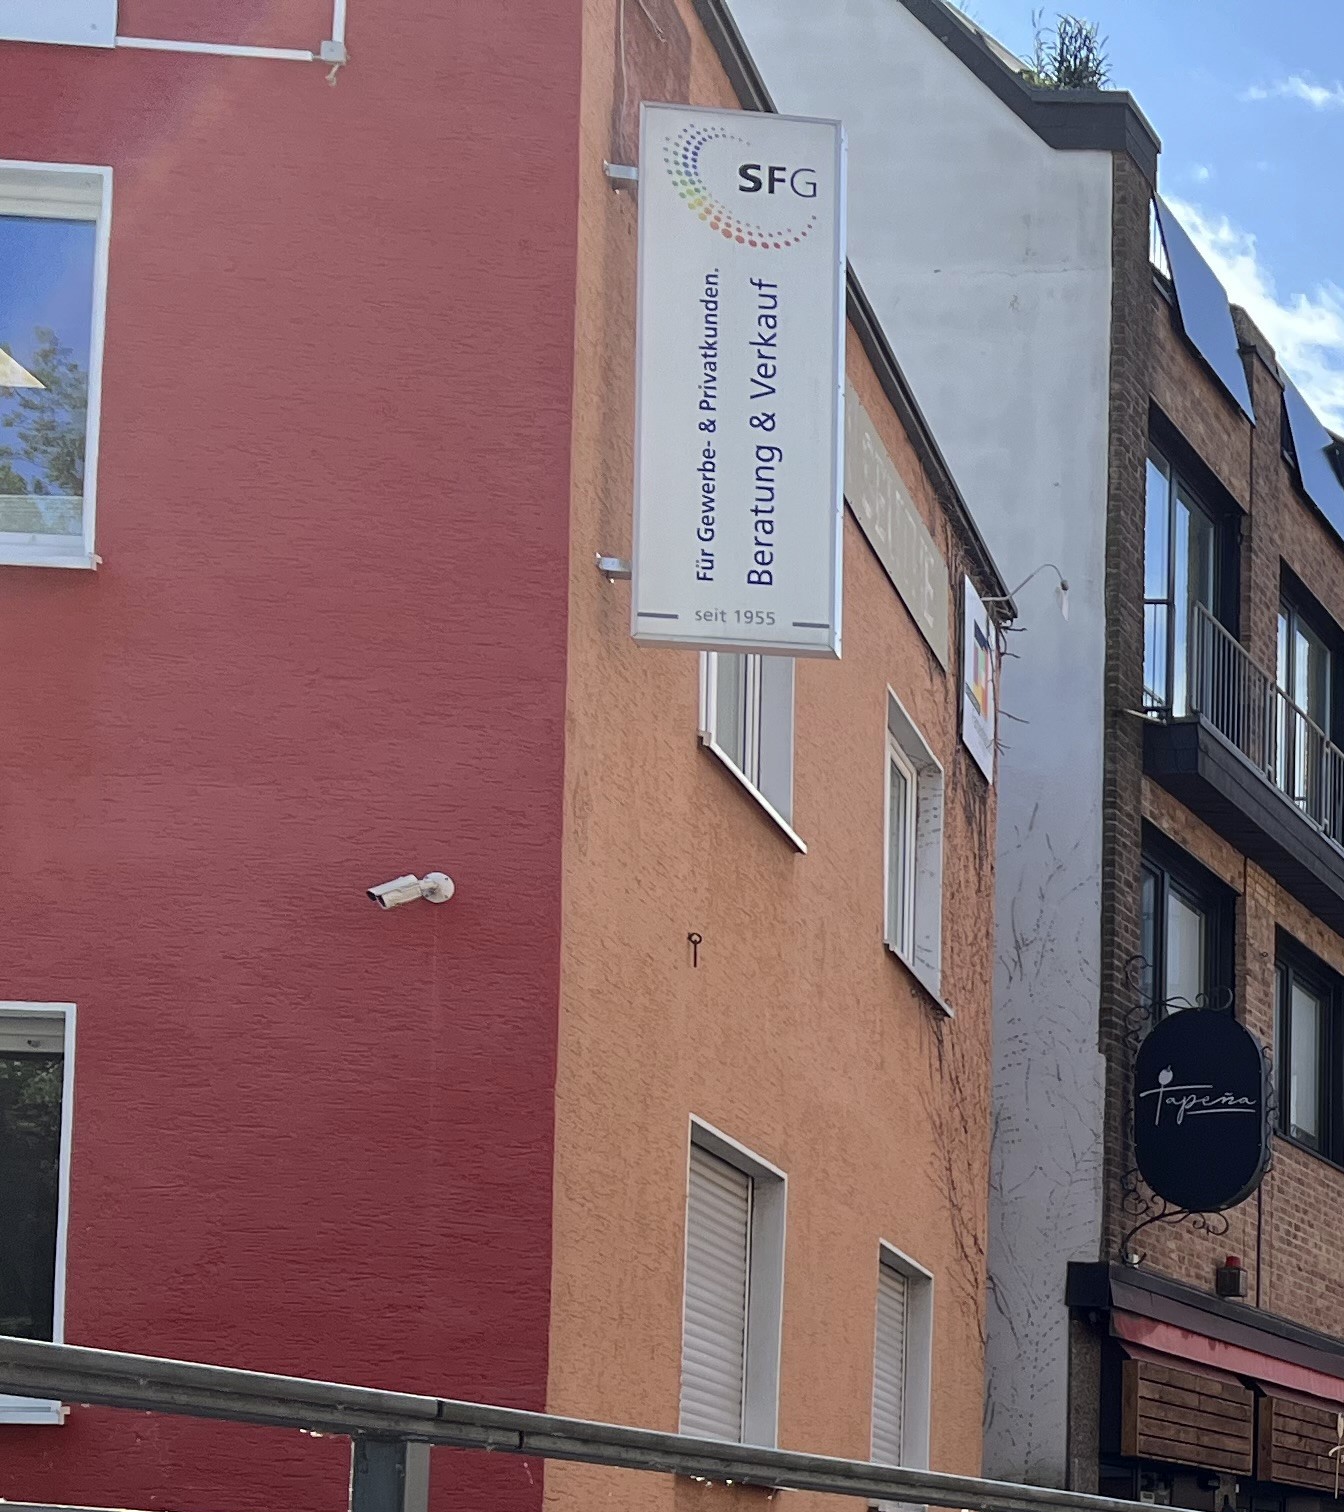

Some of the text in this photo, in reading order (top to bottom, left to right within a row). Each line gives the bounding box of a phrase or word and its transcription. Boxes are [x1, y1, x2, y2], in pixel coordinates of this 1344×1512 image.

[738, 163, 818, 198] SFG
[695, 267, 720, 582] Für Gewerbe- & Privatkunden.
[746, 276, 783, 586] Beratung & Verkauf
[694, 607, 777, 627] seit 1955
[1139, 1065, 1257, 1127] Tapeña
